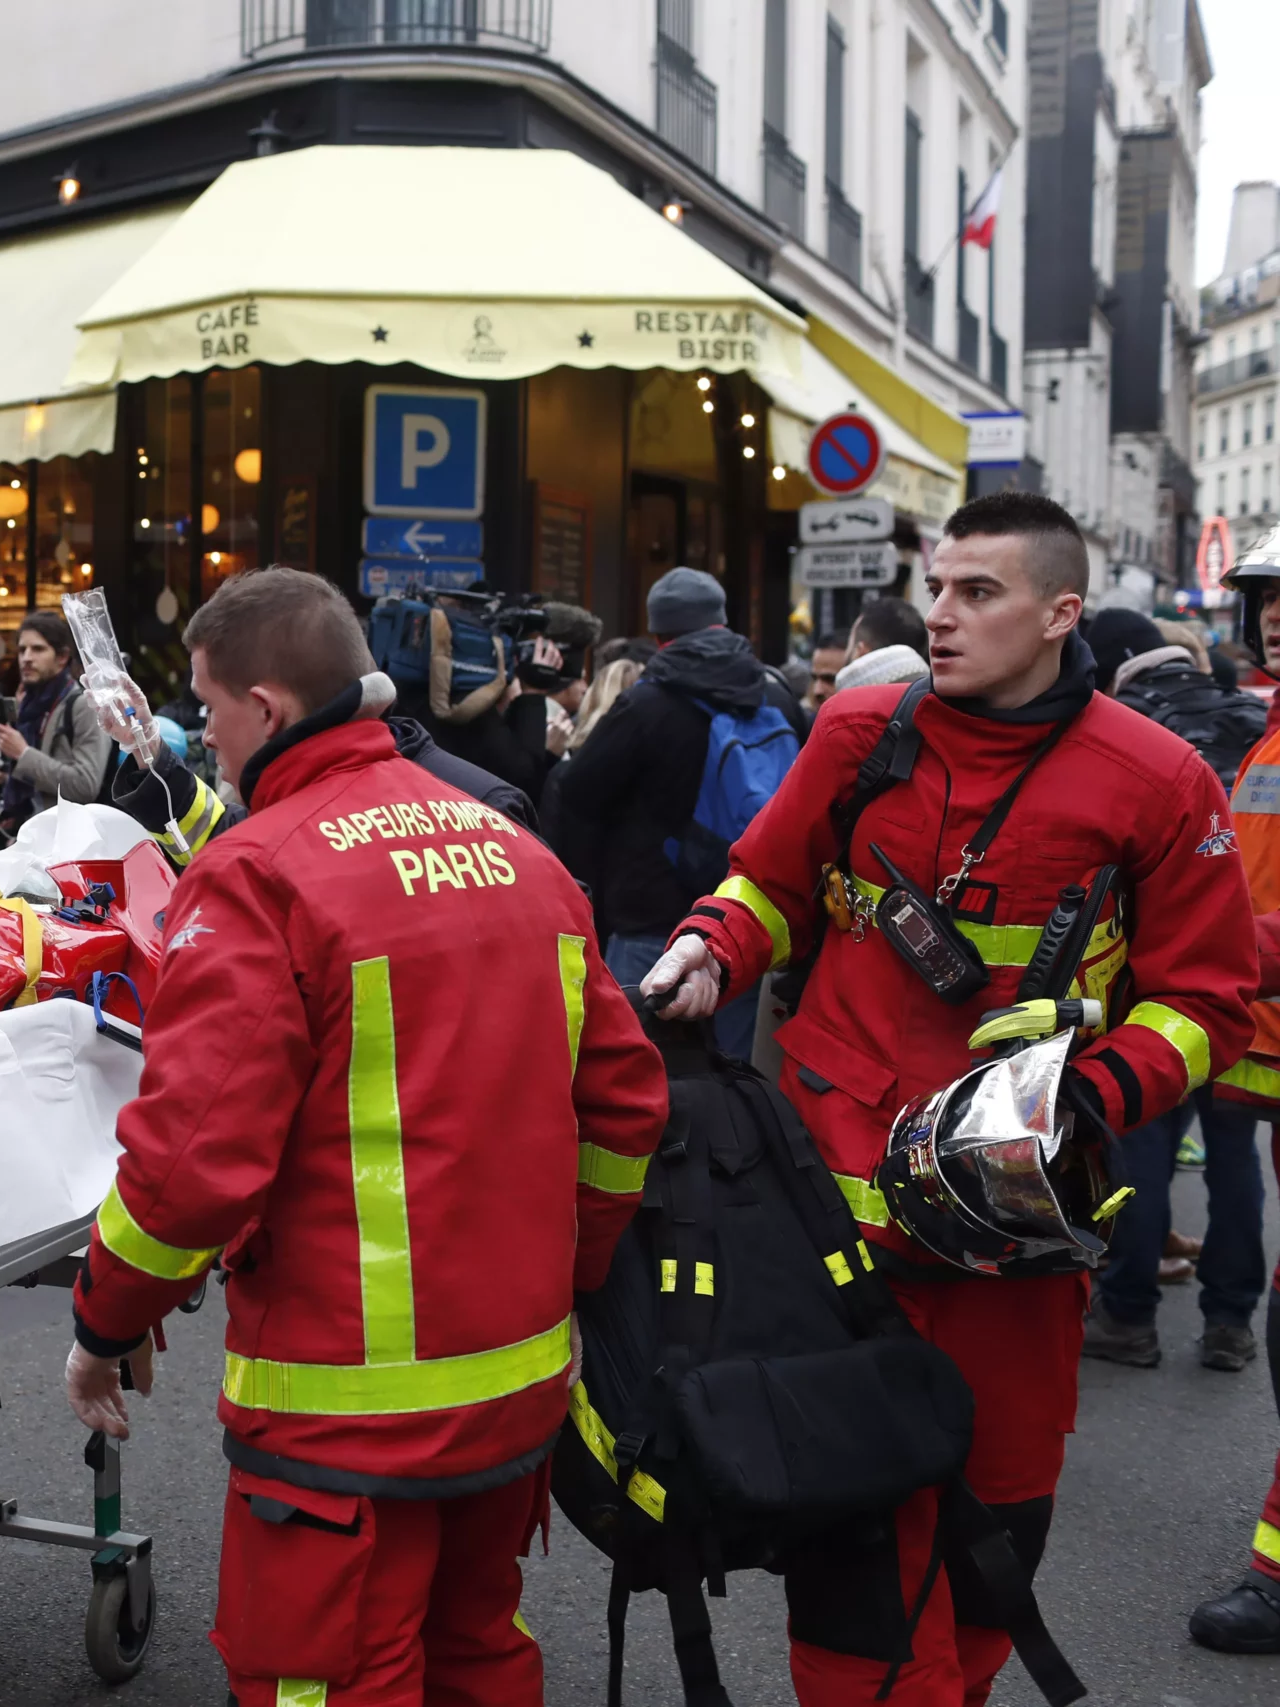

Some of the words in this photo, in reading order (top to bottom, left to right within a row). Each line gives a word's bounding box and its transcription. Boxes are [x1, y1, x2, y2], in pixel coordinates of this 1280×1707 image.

[196, 297, 259, 333] CAFÉ
[202, 333, 250, 360] BAR
[679, 339, 759, 361] BISTR
[401, 413, 451, 489] P
[319, 802, 435, 852] SAPEURS
[426, 799, 519, 838] POMPIERS
[389, 841, 517, 896] PARIS
